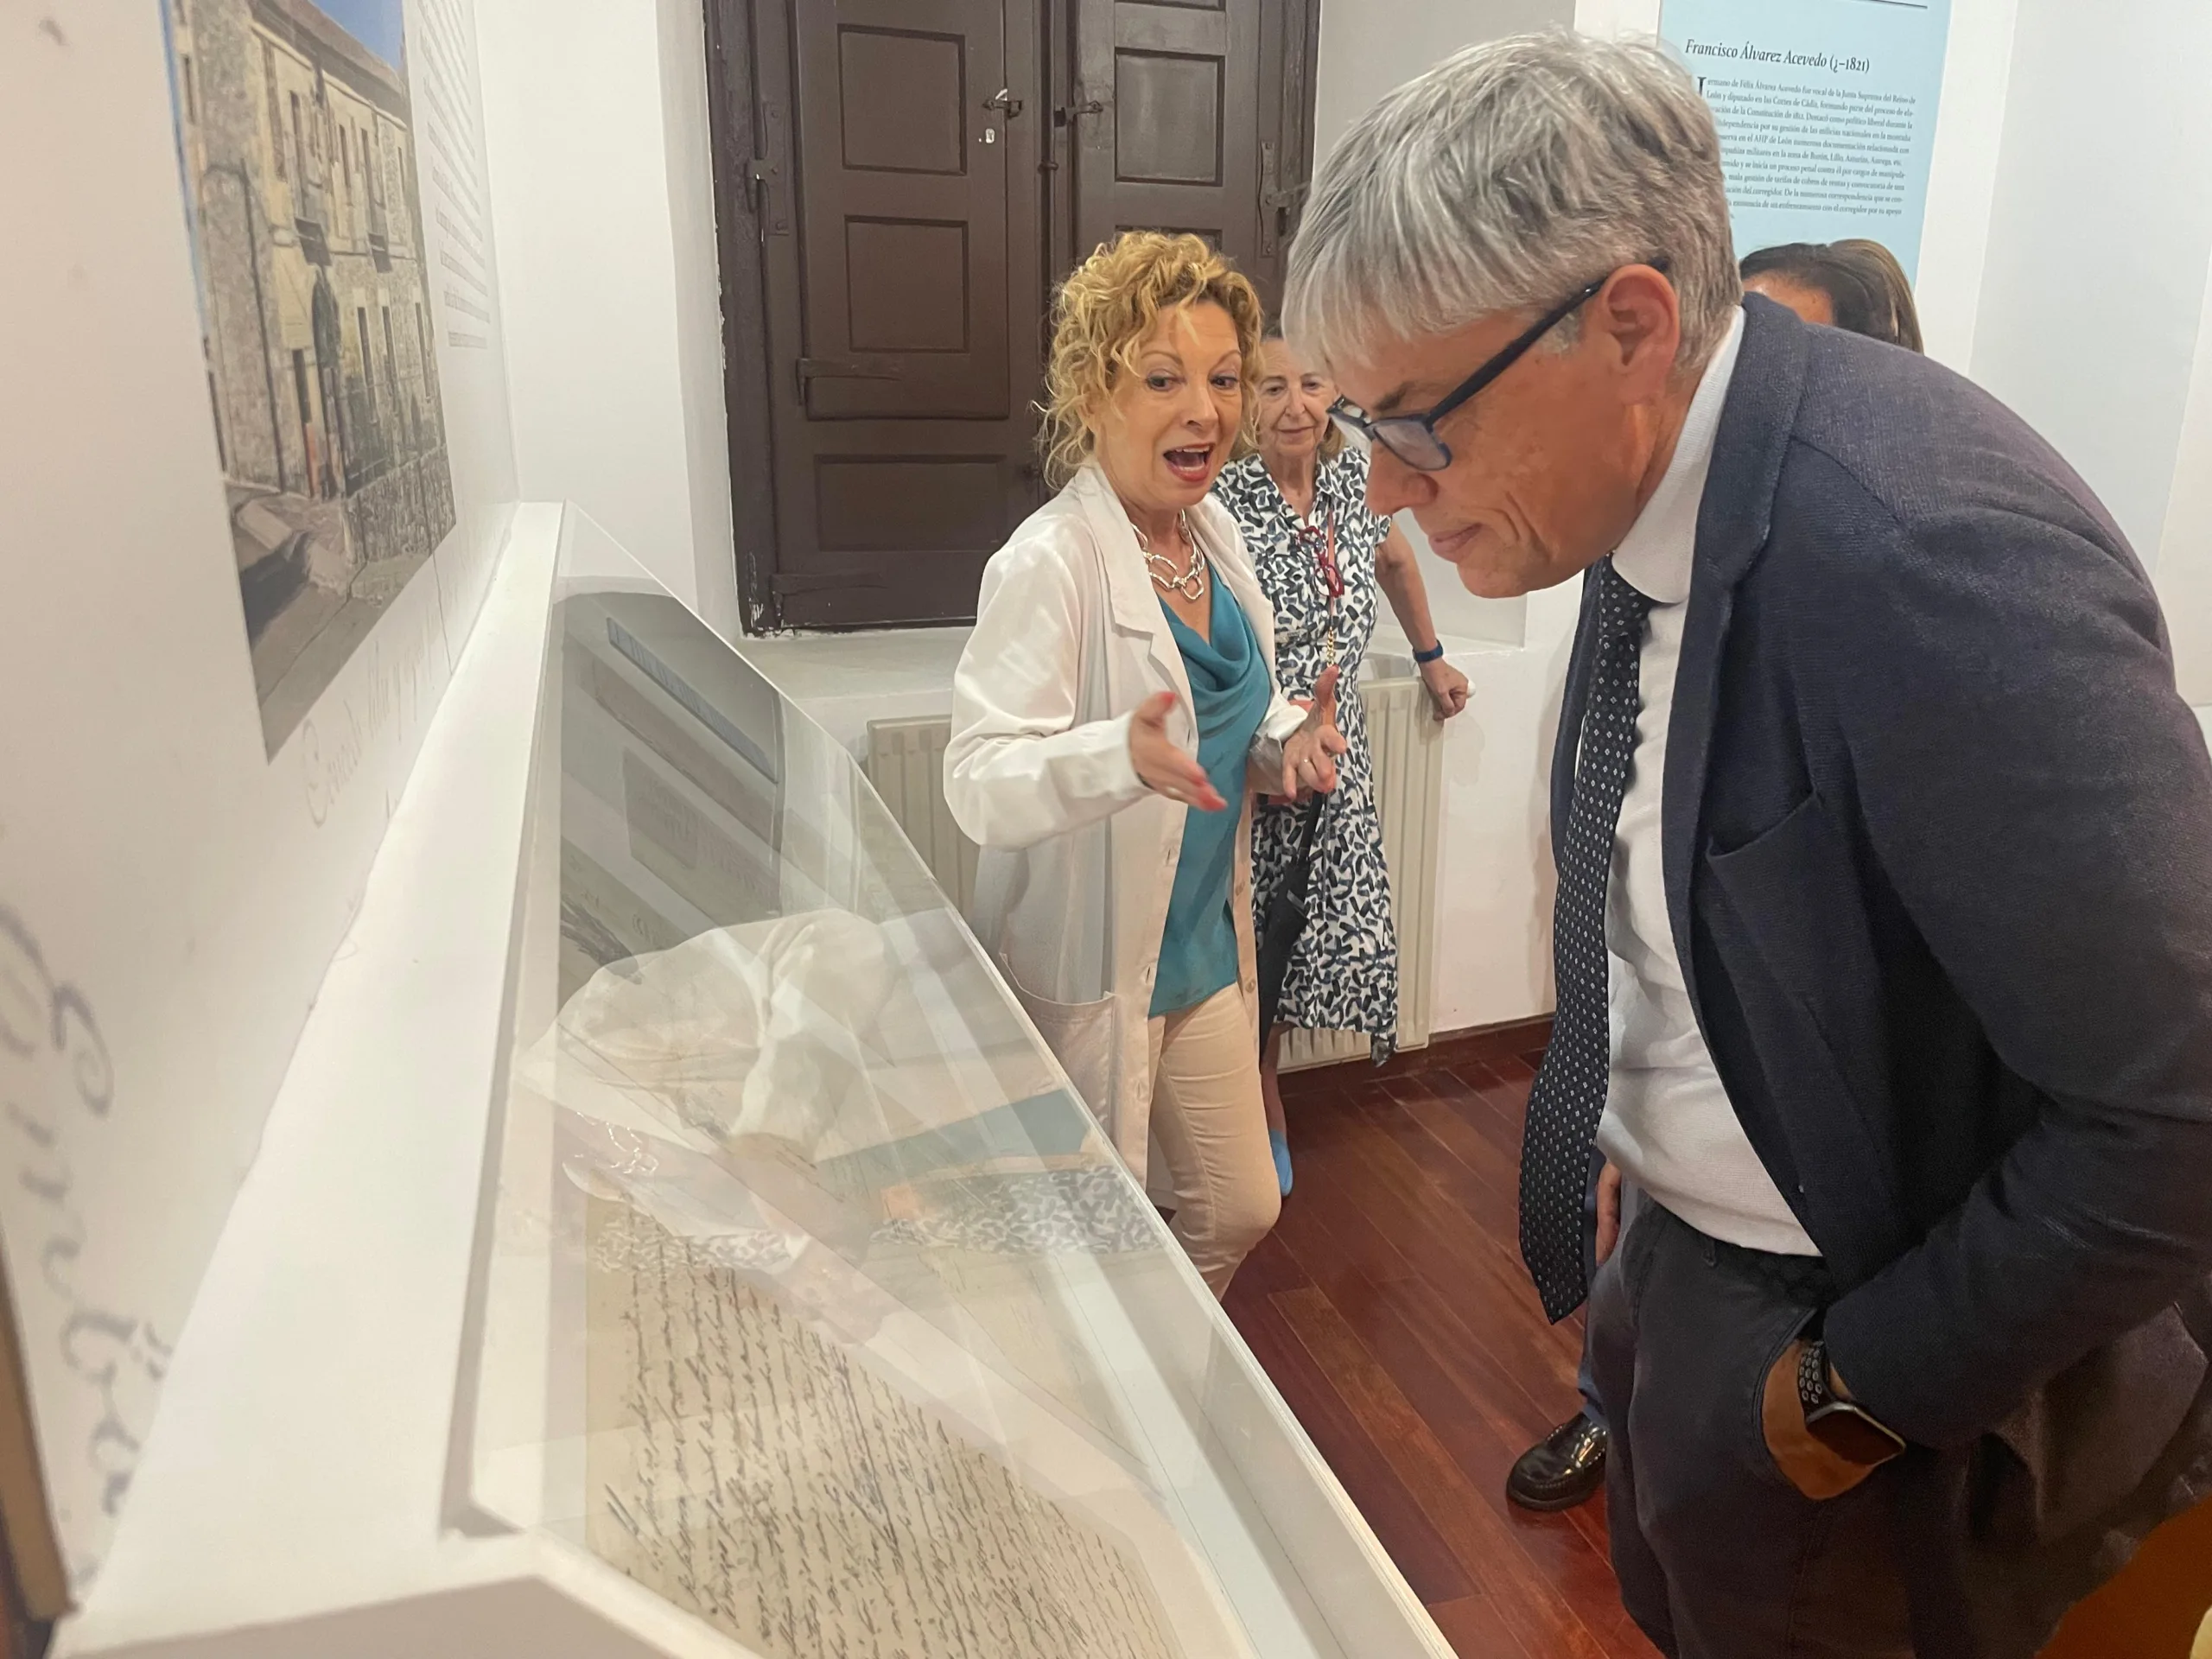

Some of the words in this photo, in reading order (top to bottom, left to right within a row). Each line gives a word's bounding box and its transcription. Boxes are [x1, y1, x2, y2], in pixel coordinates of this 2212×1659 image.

[1685, 39, 1738, 58] Francisco
[1739, 41, 1782, 62] Álvarez
[1783, 49, 1827, 67] Acevedo
